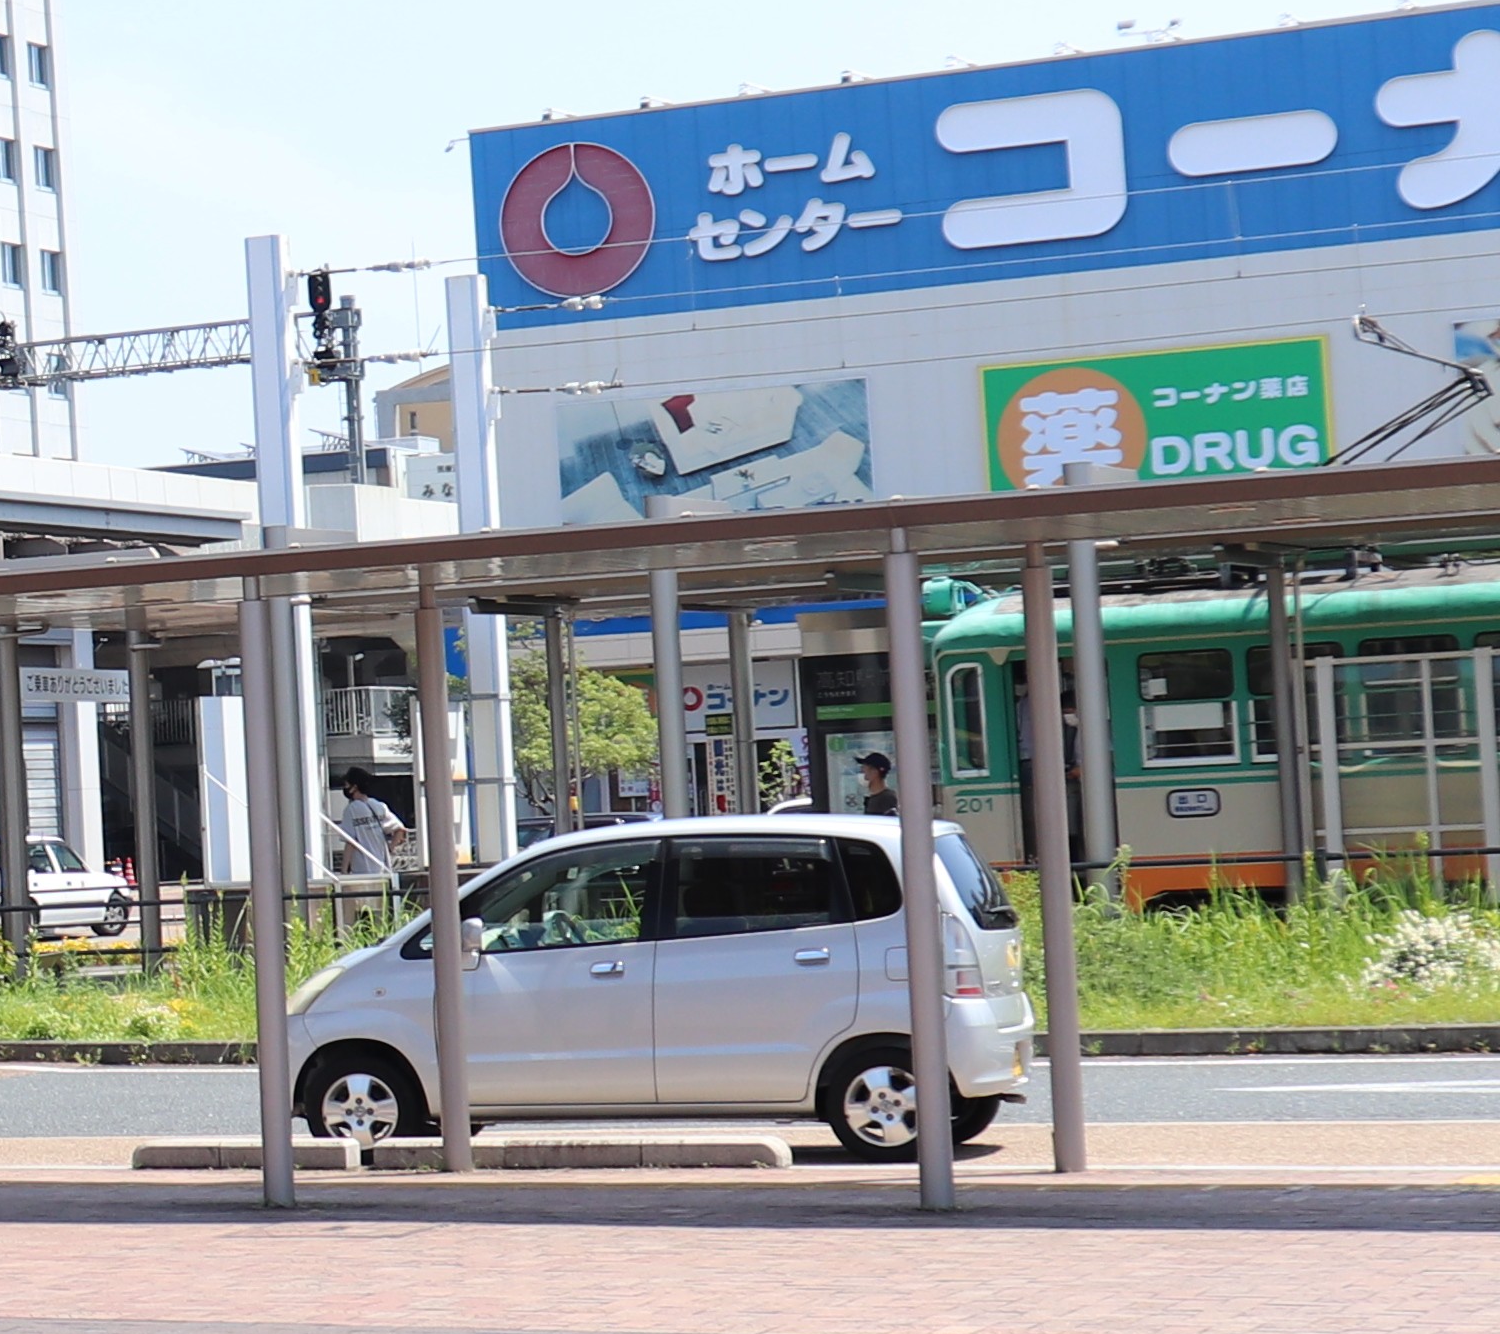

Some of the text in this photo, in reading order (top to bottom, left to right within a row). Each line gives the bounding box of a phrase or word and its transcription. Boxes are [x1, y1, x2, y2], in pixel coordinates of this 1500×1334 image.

[708, 132, 876, 195] ホーム
[689, 198, 903, 261] センター
[1152, 375, 1309, 408] コーナン薬店
[1019, 388, 1123, 486] 薬
[1150, 424, 1321, 475] DRUG
[26, 674, 129, 696] ご乗車ありがとうございました
[956, 797, 994, 814] 201
